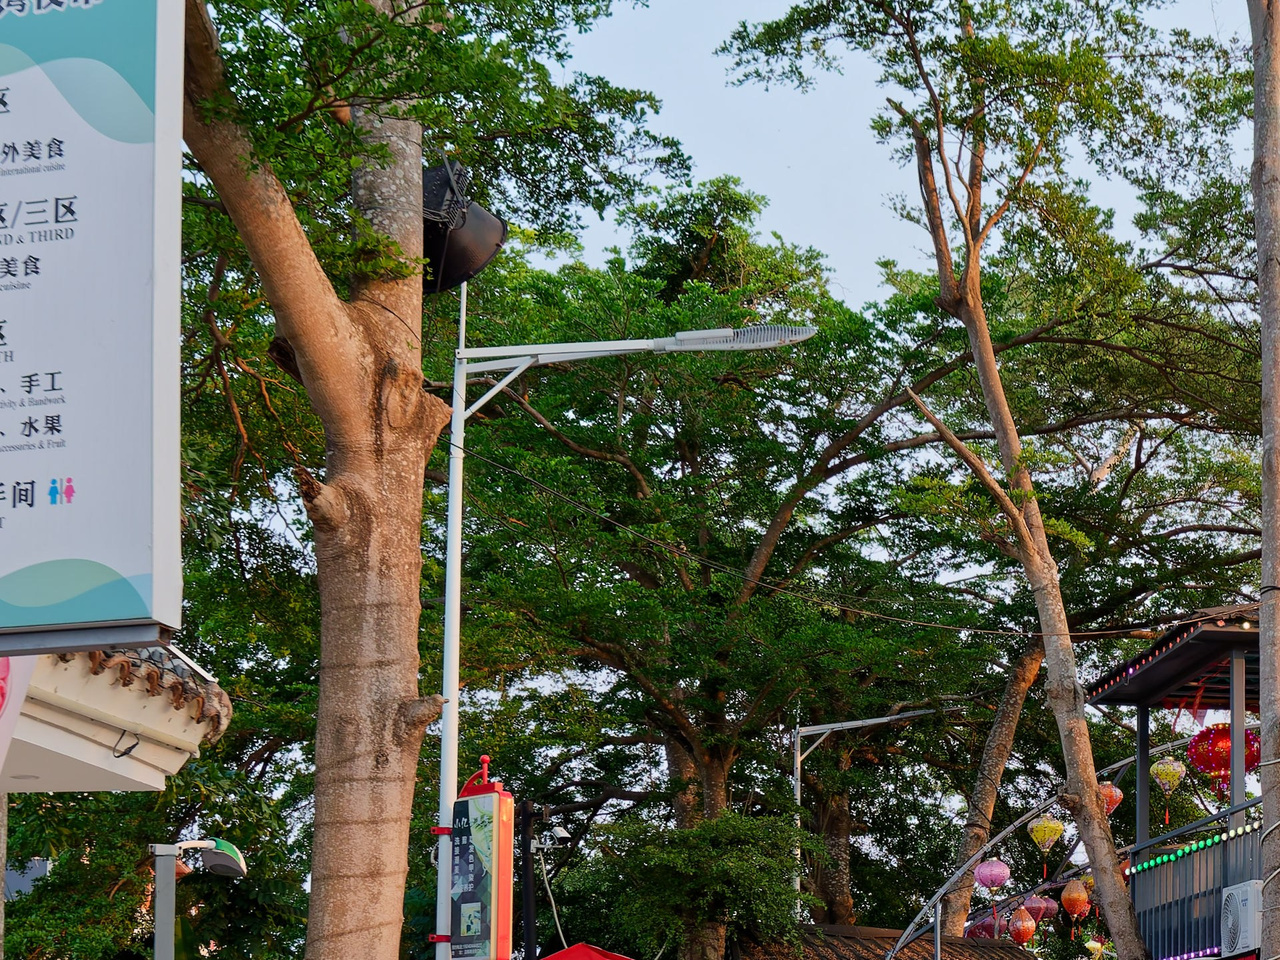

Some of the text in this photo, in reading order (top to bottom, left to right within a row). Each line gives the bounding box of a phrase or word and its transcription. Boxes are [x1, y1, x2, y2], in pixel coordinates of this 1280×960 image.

[16, 235, 24, 244] &
[28, 227, 74, 243] THIRD
[0, 255, 40, 278] 美食
